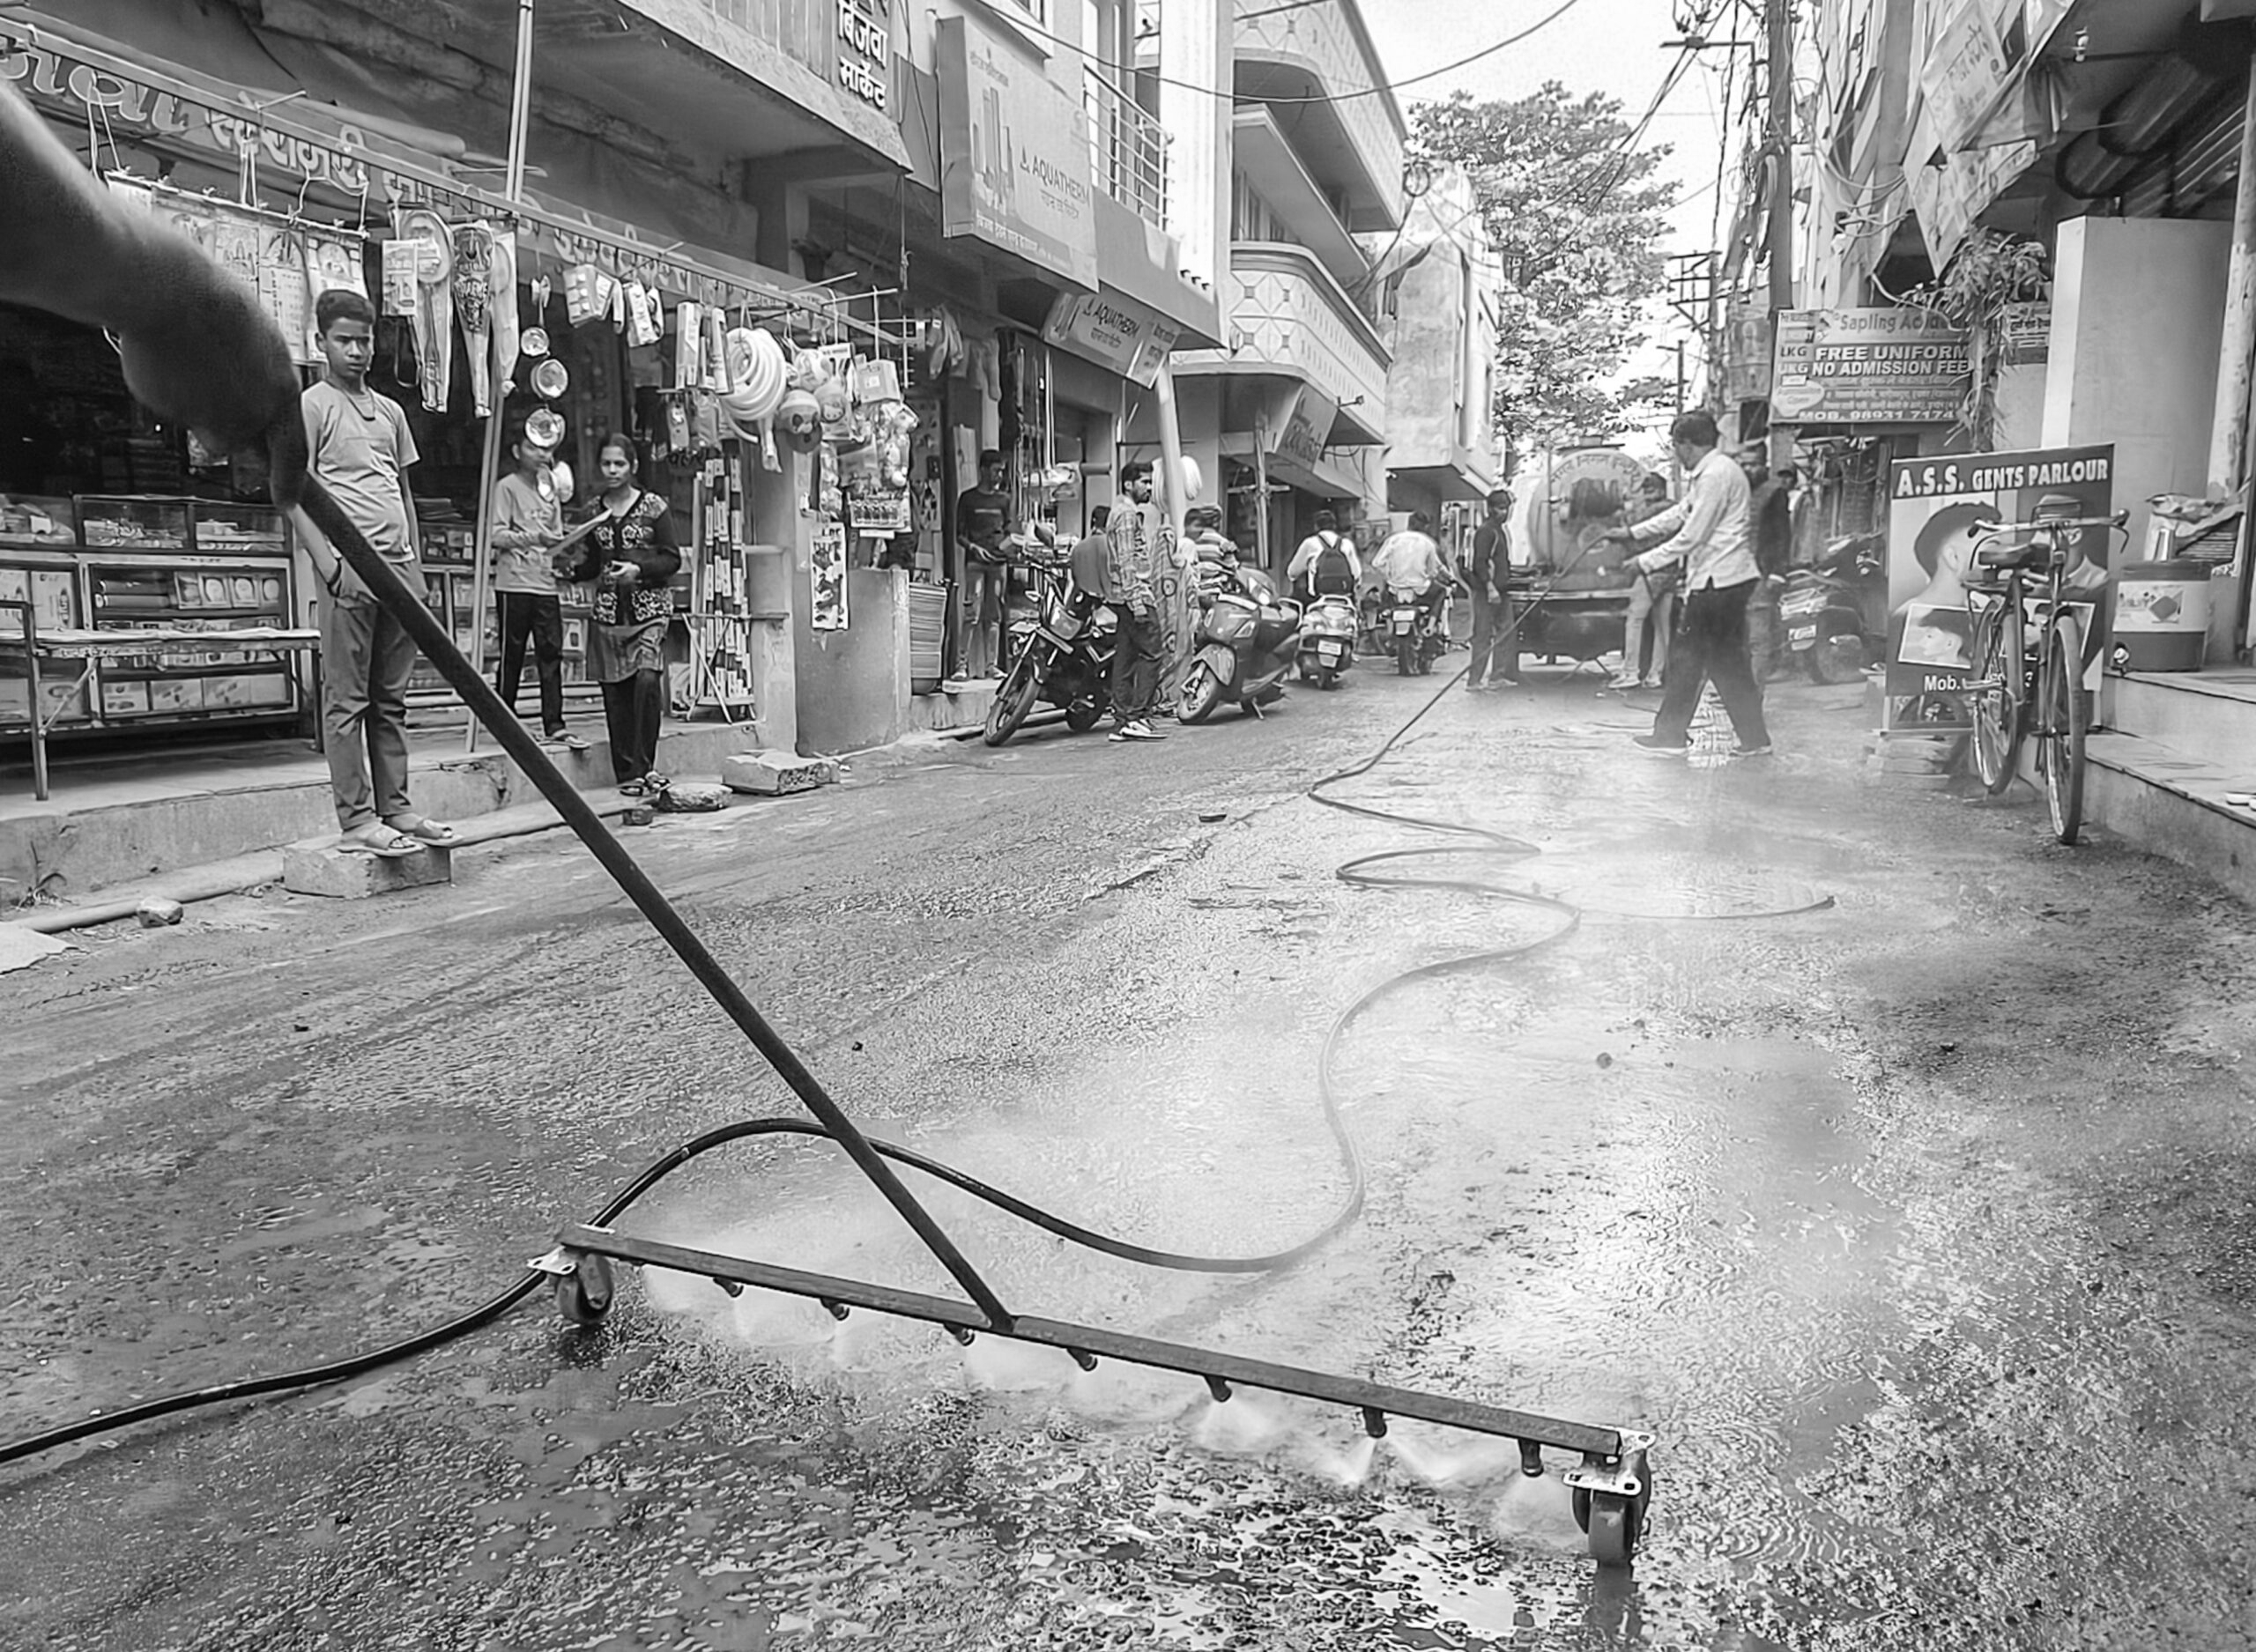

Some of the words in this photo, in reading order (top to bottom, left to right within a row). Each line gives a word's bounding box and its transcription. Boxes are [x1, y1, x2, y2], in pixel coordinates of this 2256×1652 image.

[839, 55, 887, 108] मार्केट
[1032, 154, 1091, 209] AQUATHERM
[1092, 301, 1141, 339] AQUATHERM
[1840, 313, 1896, 334] Sapling
[1780, 346, 1807, 357] LKG
[1815, 346, 1869, 361] FREE
[1874, 344, 1969, 360] UNIFORM
[1778, 362, 1809, 374] UKG
[1812, 361, 1836, 376] NO
[1839, 360, 1933, 375] ADMISSION
[1799, 411, 1844, 420] MOB.
[1910, 410, 1955, 419] 7174
[1896, 464, 1965, 497] A.S.S.
[1972, 465, 2025, 492] GENTS
[2029, 458, 2109, 486] PARLOUR
[1924, 674, 1962, 692] Mob.
